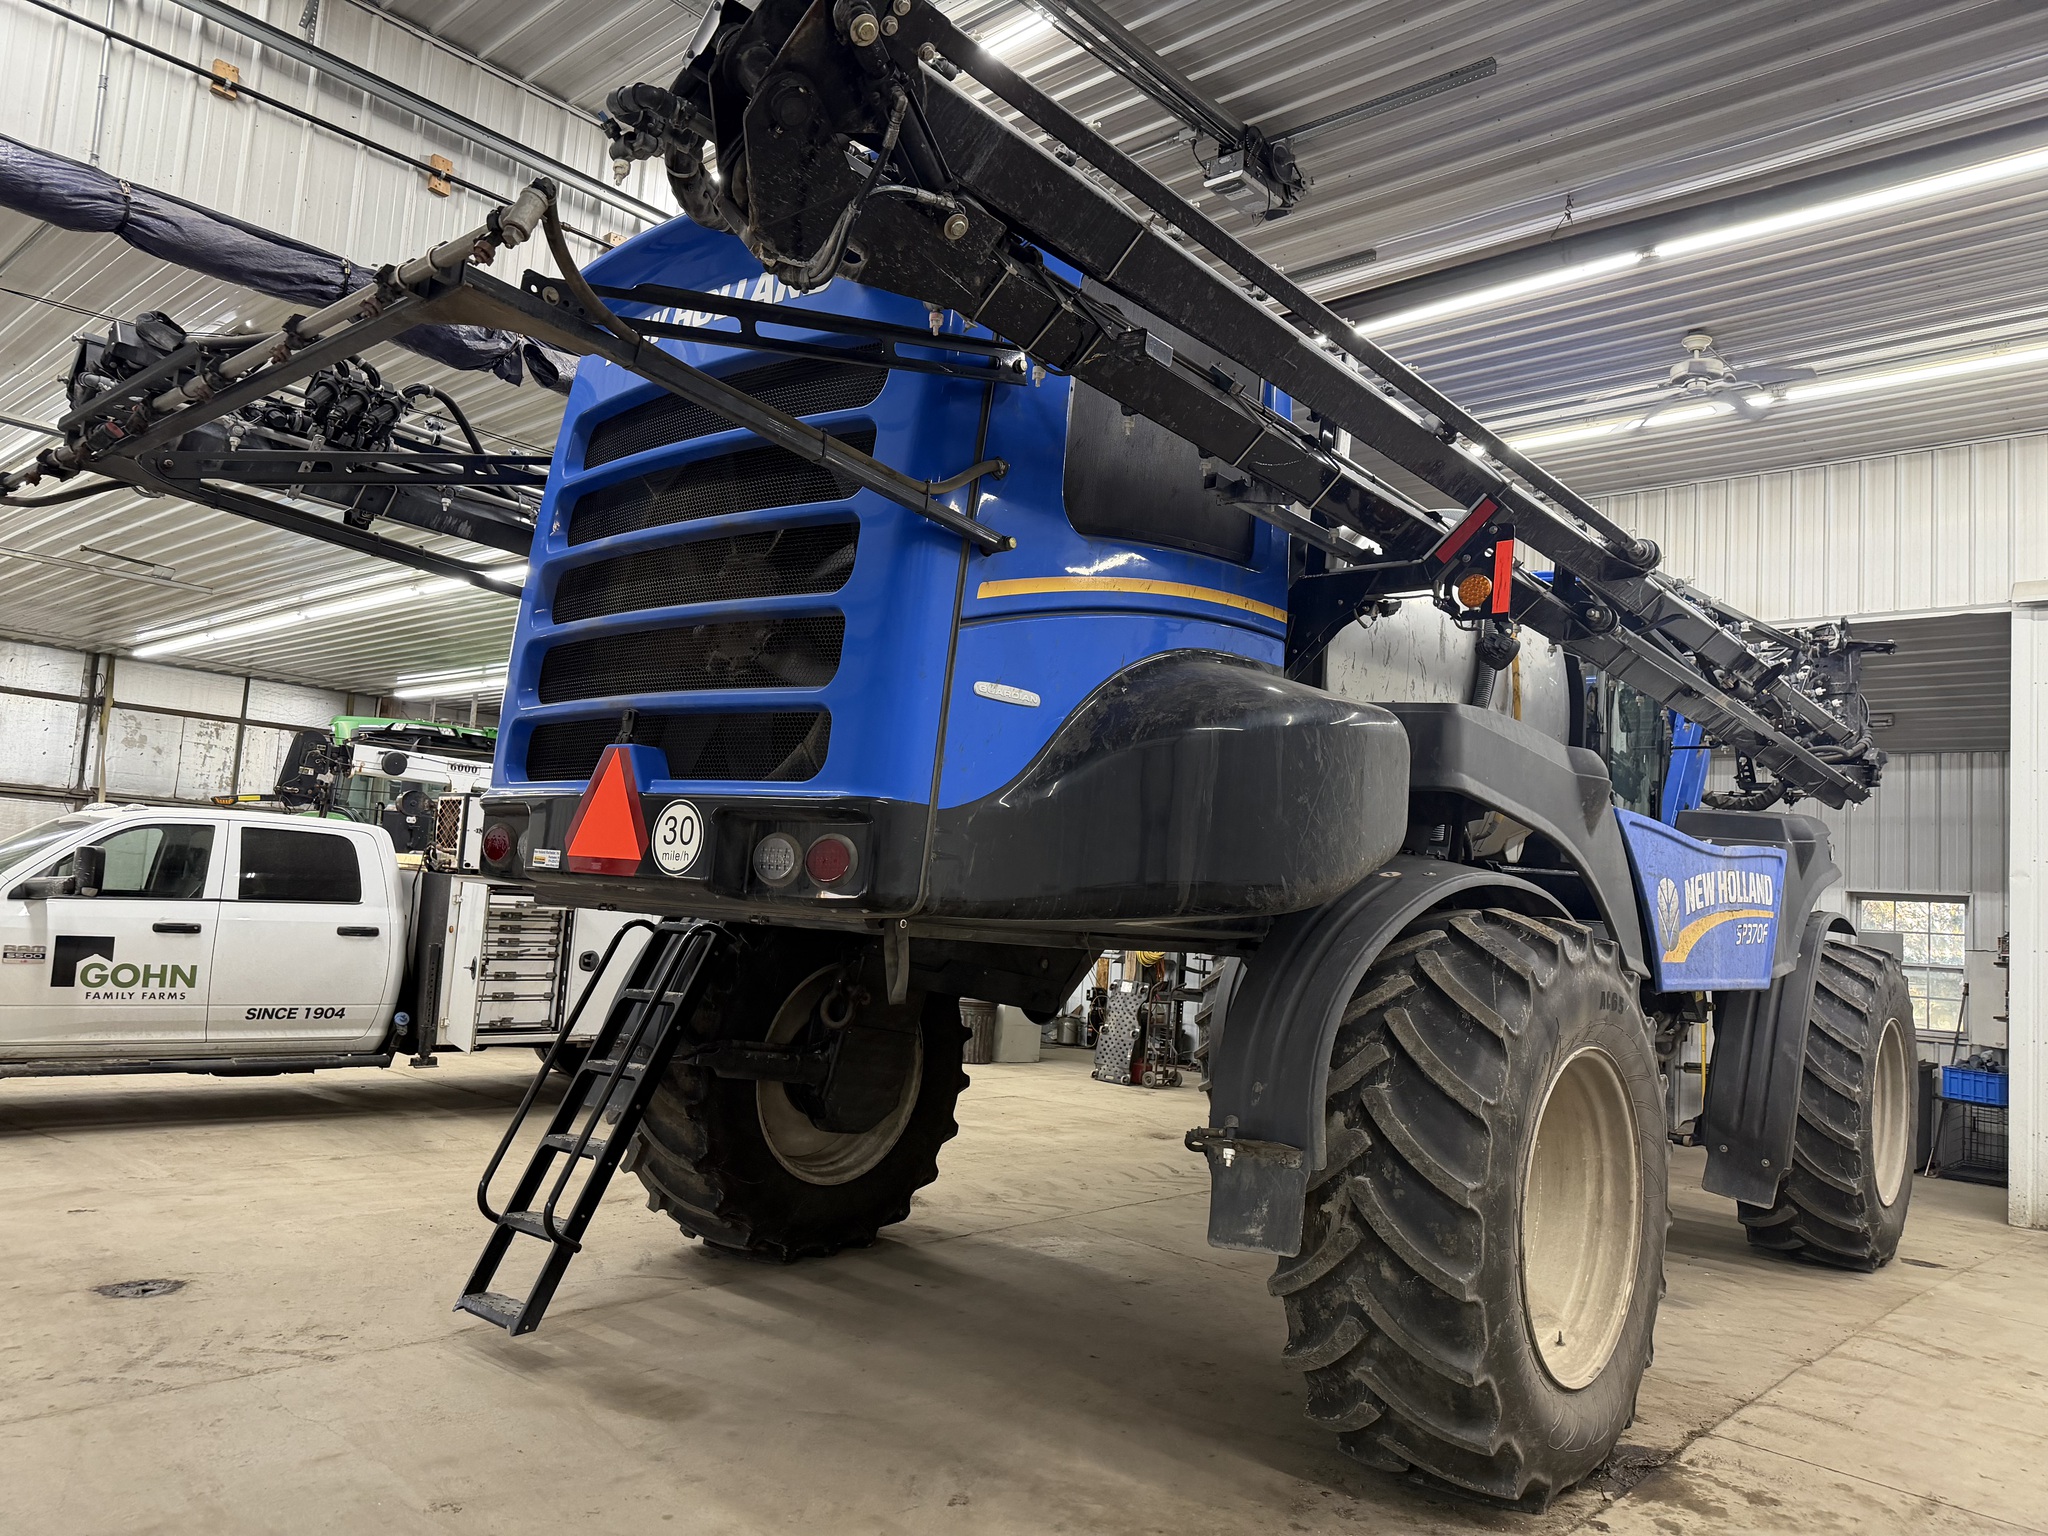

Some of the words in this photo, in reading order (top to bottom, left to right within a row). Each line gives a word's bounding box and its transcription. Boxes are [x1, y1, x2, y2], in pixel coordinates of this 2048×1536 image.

[979, 684, 1038, 704] GUARDIAN
[450, 763, 478, 774] 6000
[663, 815, 695, 846] 30
[661, 850, 690, 861] mile/h
[1684, 871, 1715, 916] NEW
[1717, 869, 1773, 906] HOLLAND
[1735, 923, 1769, 945] SP370F
[79, 962, 198, 988] GOHN
[85, 991, 135, 1000] FAMILY
[141, 991, 187, 1000] FARMS
[245, 1007, 299, 1020] SINCE
[304, 1007, 346, 1019] 1904
